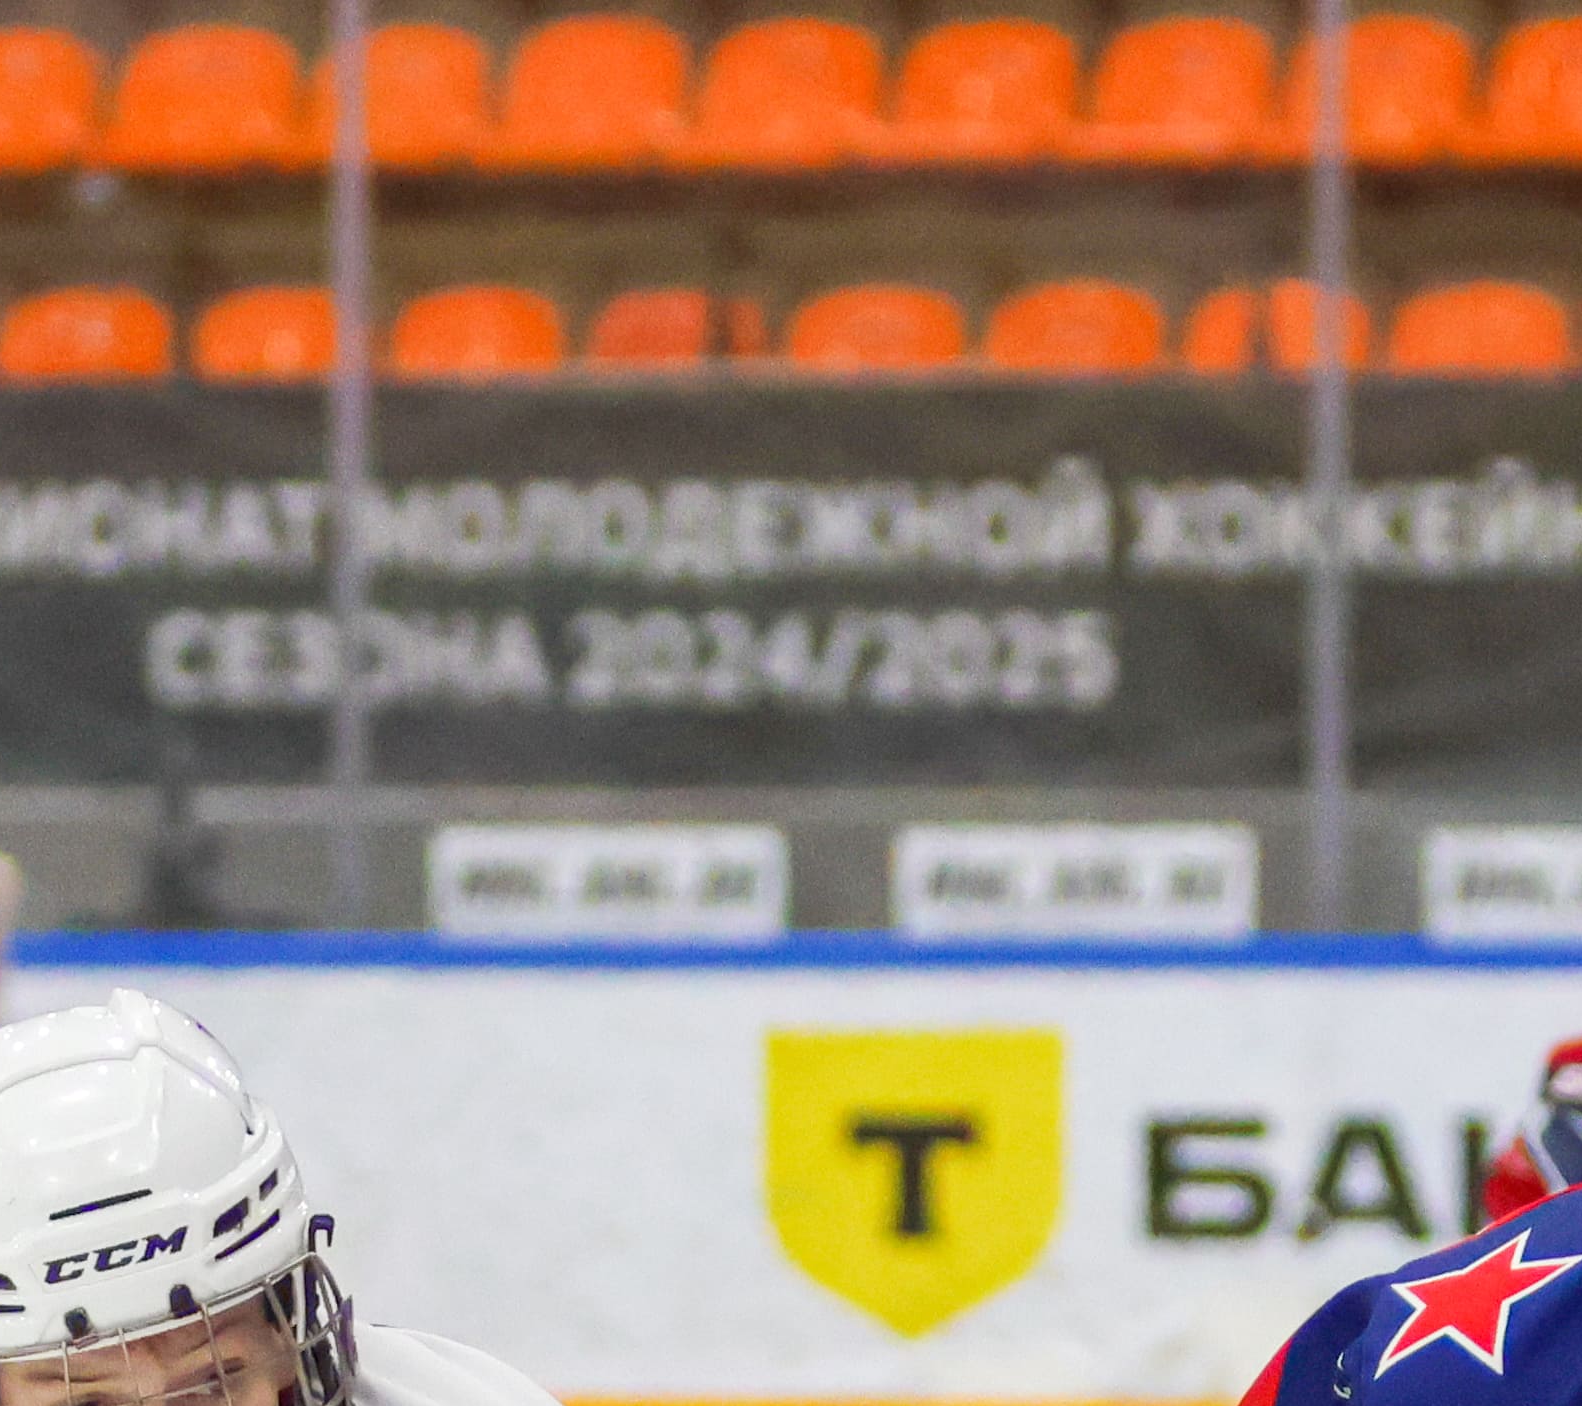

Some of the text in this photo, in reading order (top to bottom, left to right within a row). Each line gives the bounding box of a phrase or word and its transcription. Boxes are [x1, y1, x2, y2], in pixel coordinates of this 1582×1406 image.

[146, 608, 1116, 708] СЕЗОНА 2024/2025
[44, 1225, 189, 1285] CCM
